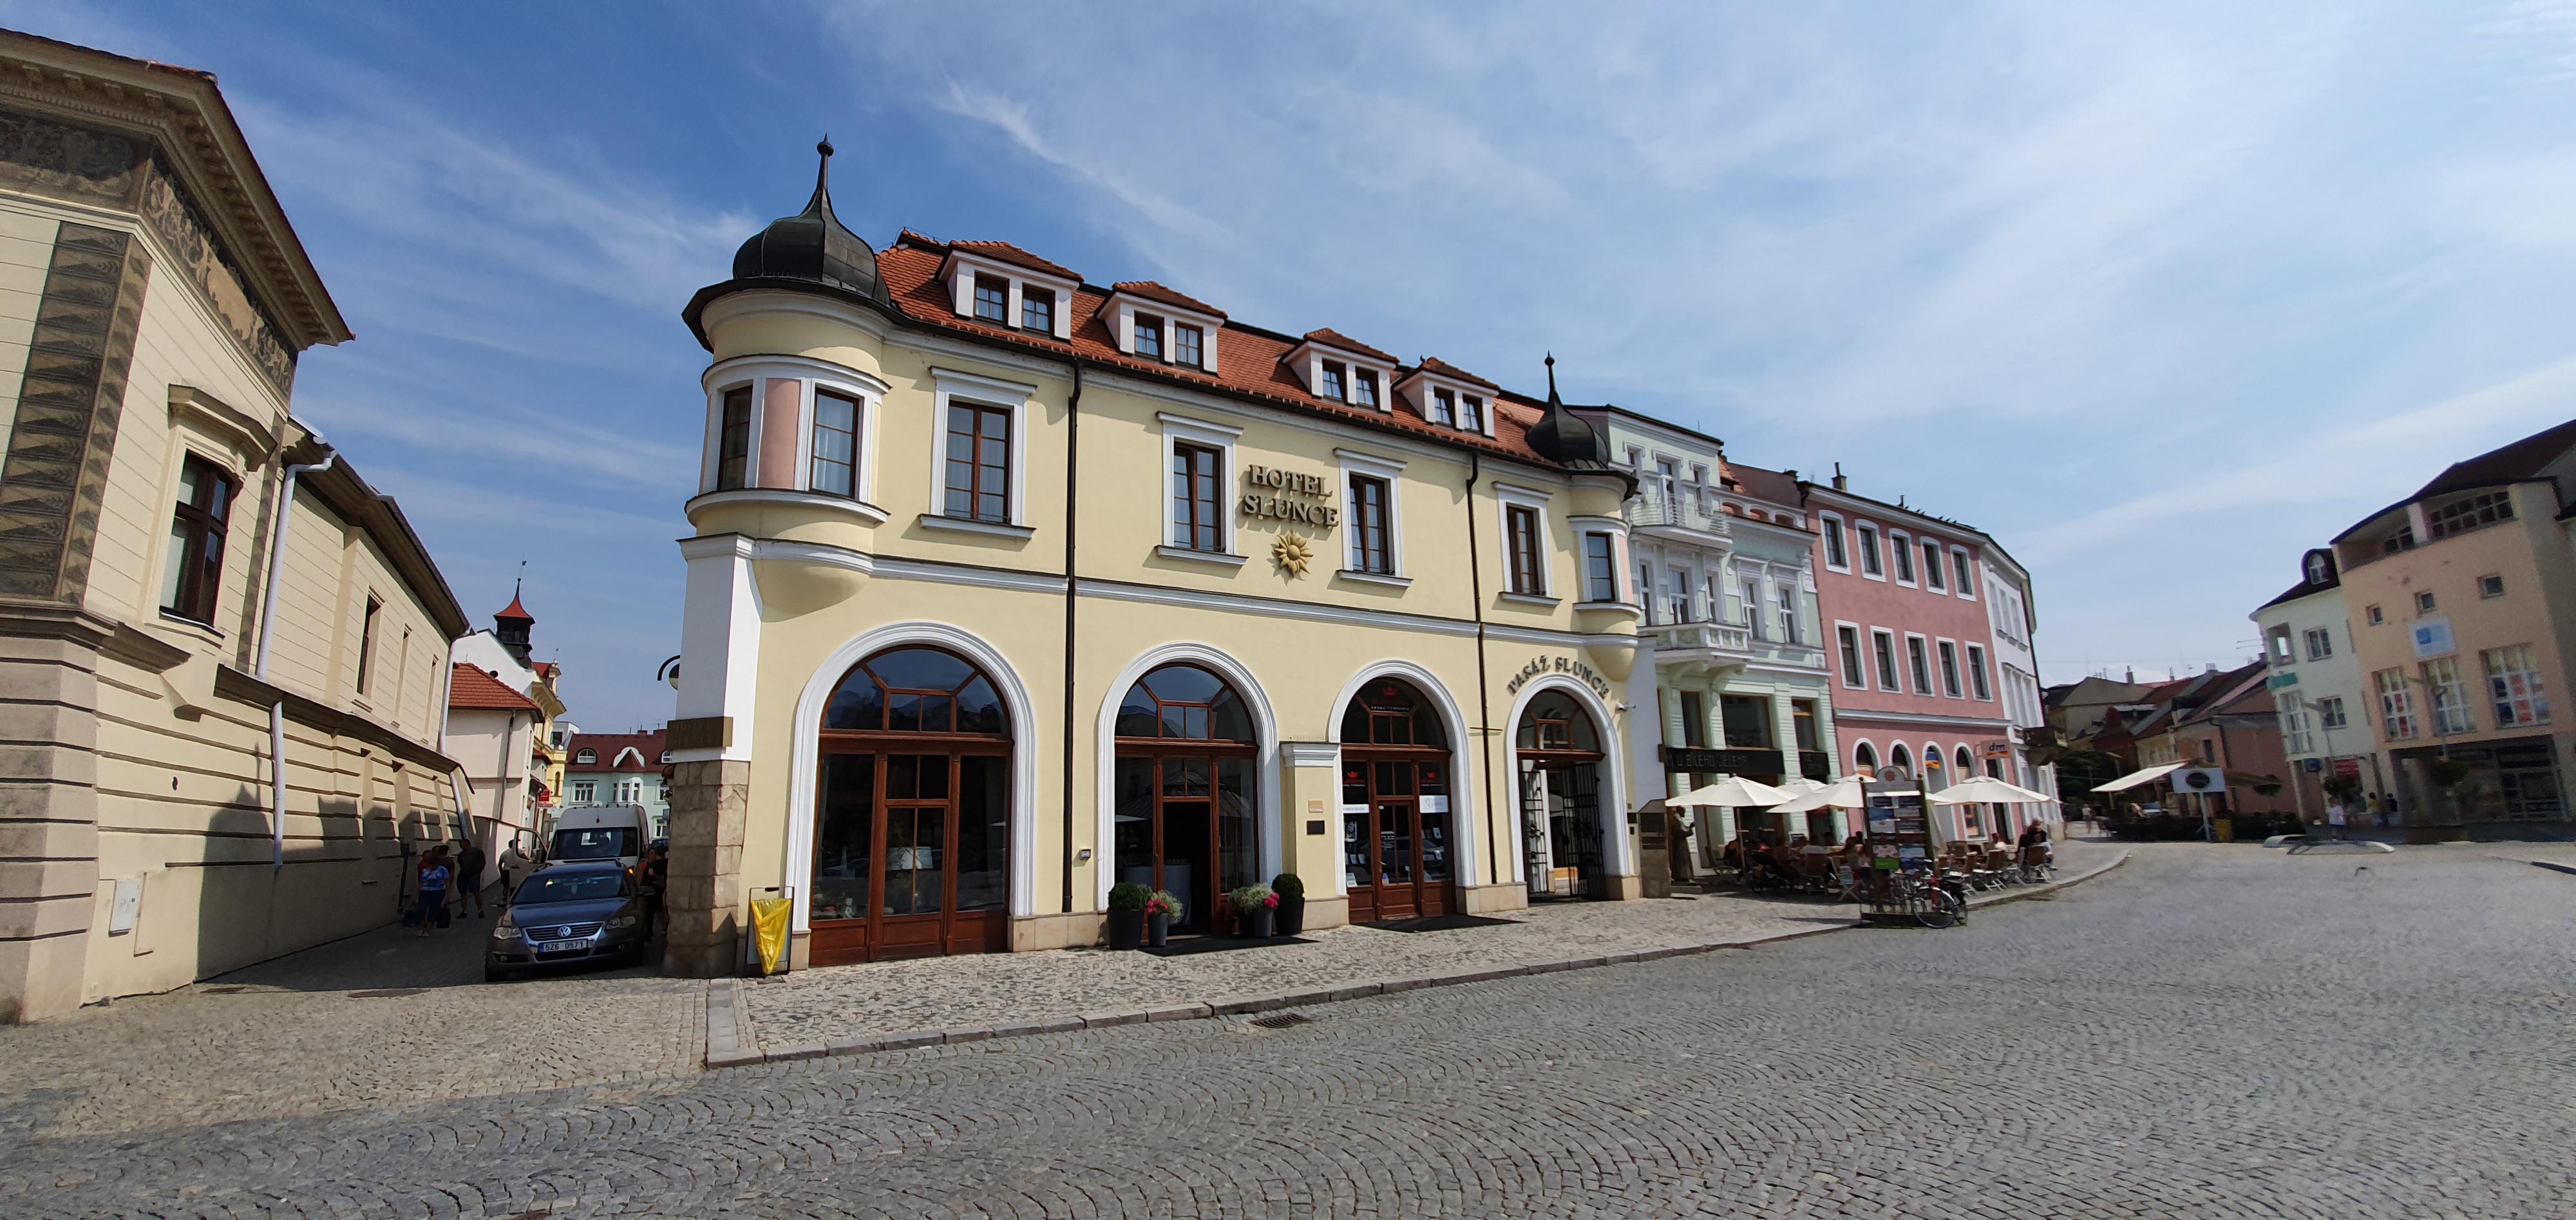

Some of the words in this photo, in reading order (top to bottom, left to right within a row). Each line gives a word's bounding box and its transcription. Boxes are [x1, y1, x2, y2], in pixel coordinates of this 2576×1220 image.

[1249, 464, 1333, 498] HOTEL
[1243, 494, 1339, 527] SLUNCE
[1555, 657, 1609, 699] SLUNCE
[1989, 742, 2005, 751] dm
